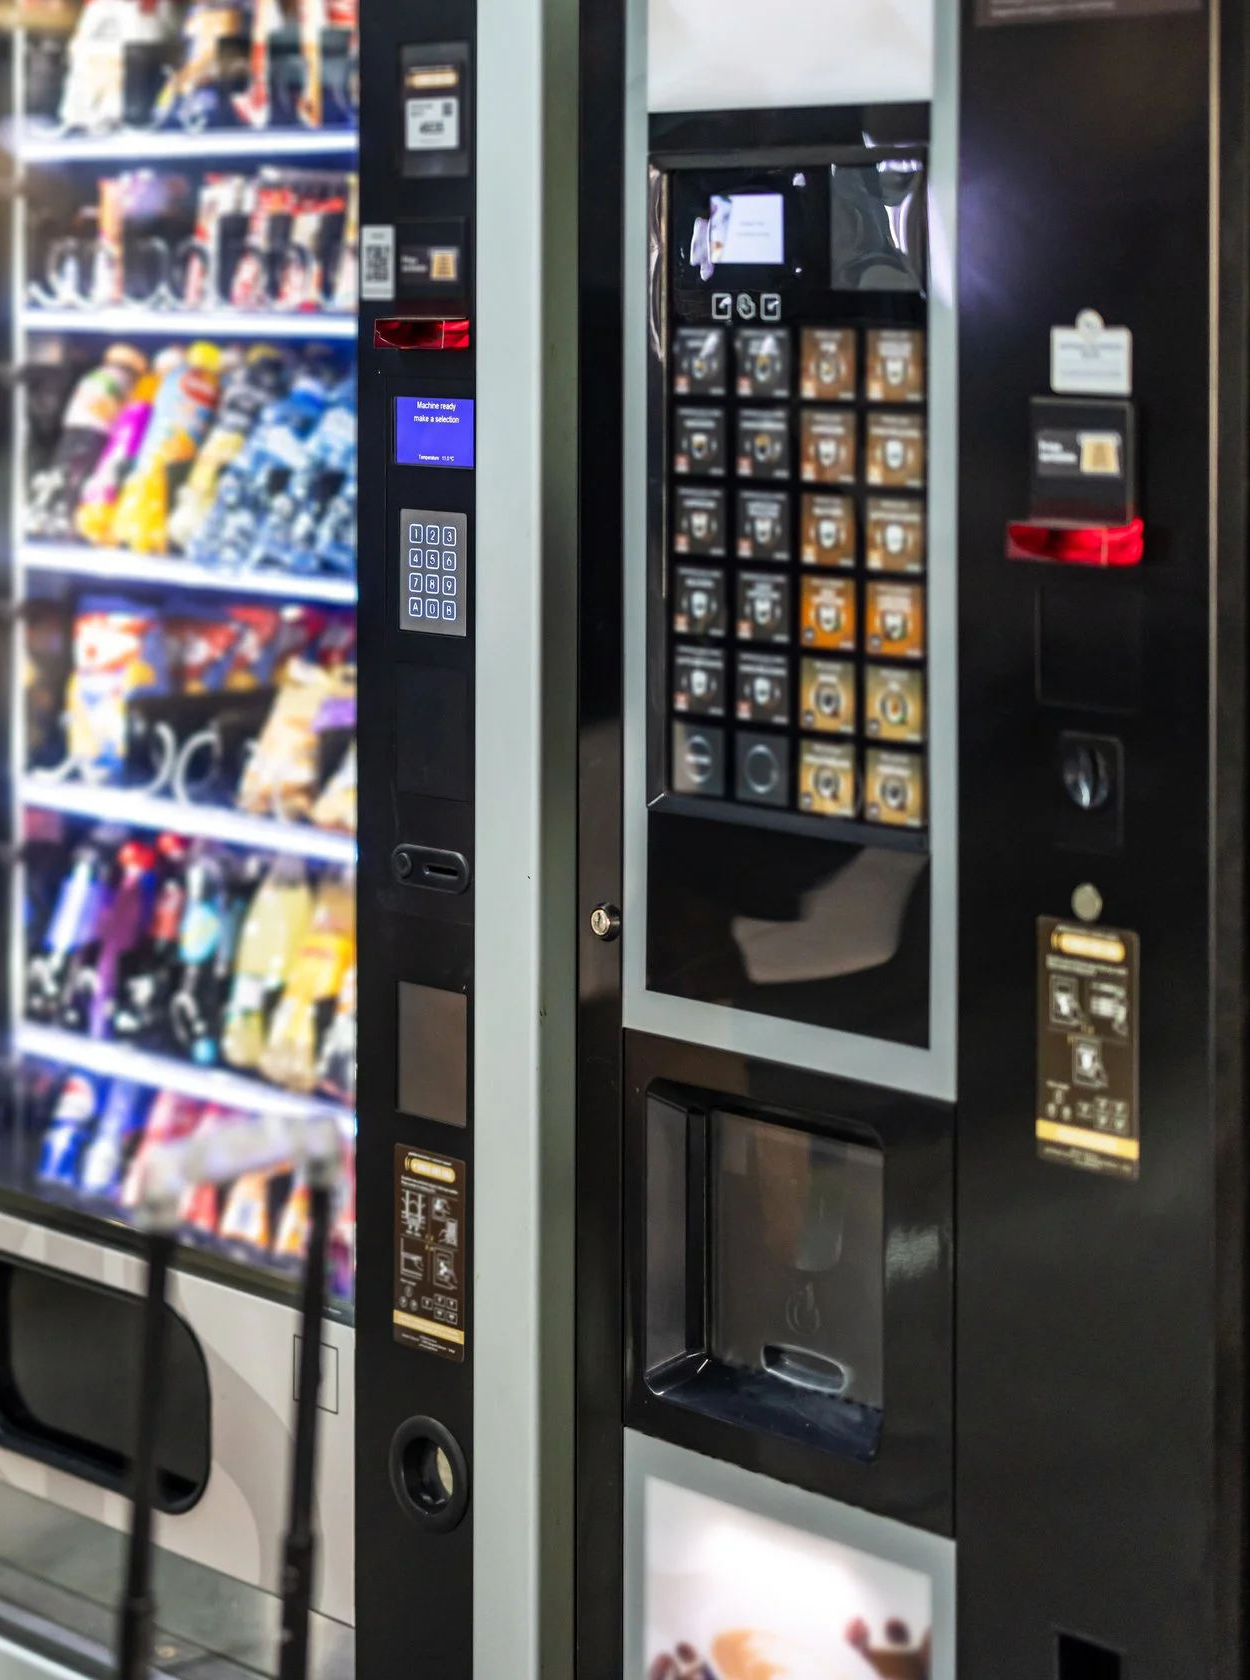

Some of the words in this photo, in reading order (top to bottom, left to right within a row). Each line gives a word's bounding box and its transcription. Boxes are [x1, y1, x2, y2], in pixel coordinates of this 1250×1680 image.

[416, 401, 439, 409] Machine
[440, 402, 457, 411] ready
[413, 414, 429, 422] make
[435, 415, 459, 424] selection
[414, 529, 418, 539] 1
[430, 530, 435, 541] 2
[446, 531, 452, 542] 3
[413, 554, 418, 563] 4
[429, 554, 435, 565] 5
[446, 556, 452, 566] 6
[413, 578, 418, 588] 7
[429, 579, 435, 590] 8
[446, 580, 452, 591] 9
[412, 602, 418, 612] A
[446, 605, 452, 616] B
